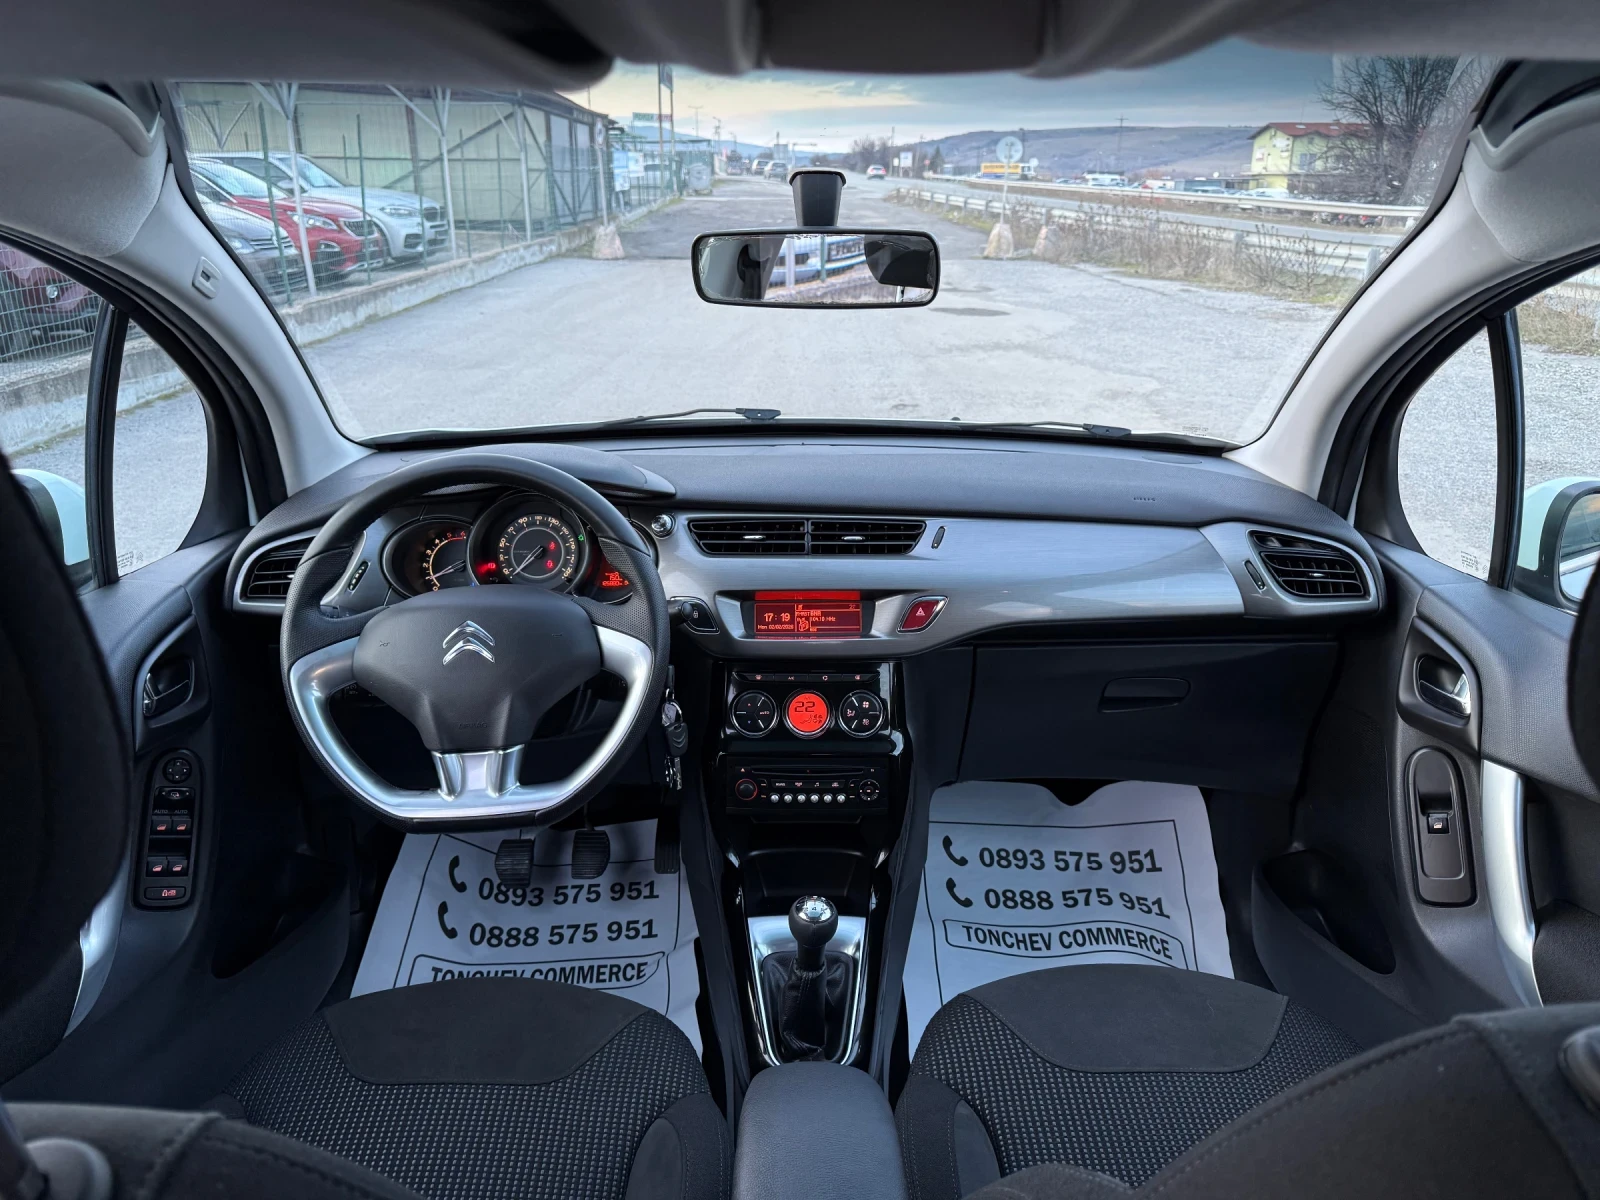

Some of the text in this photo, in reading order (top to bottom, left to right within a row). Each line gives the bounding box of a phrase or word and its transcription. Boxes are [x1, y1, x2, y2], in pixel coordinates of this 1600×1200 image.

[794, 701, 815, 713] 22
[978, 846, 1162, 874] 0893 575 951
[478, 876, 660, 907] 0893 575 951
[984, 887, 1171, 919] 0888 575 951
[469, 918, 659, 948] 0888 575 951
[961, 925, 1173, 960] TONCHEV COMMERCE
